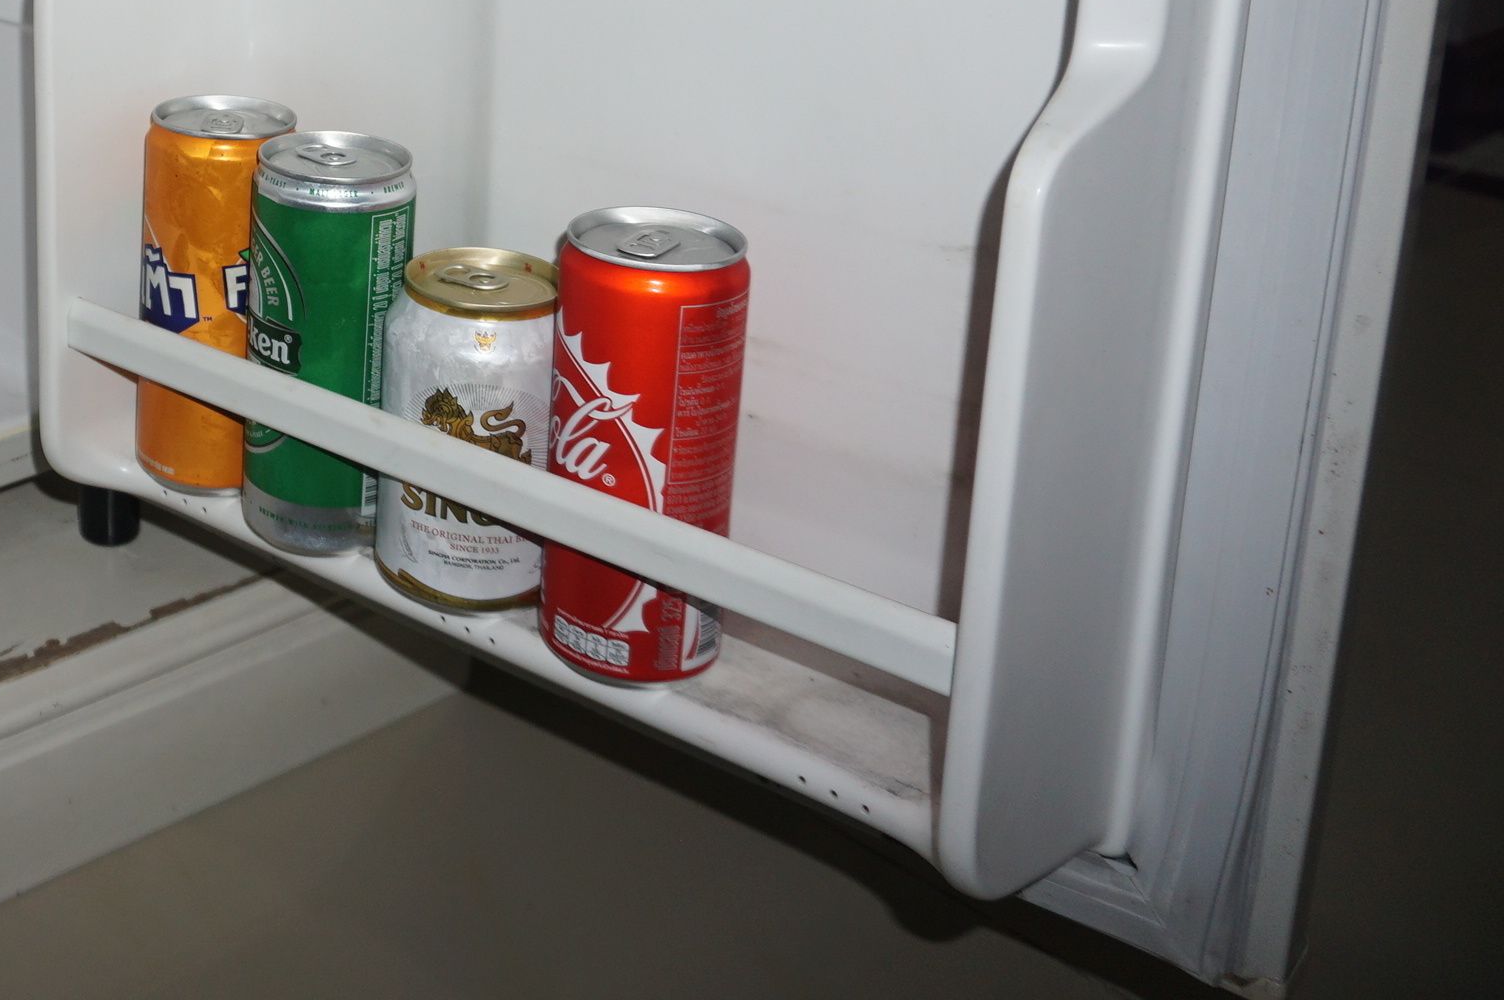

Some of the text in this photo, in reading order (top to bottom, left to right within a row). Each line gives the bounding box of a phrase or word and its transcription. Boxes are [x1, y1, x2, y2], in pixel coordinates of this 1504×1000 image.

[261, 266, 280, 306] BEER
[411, 519, 430, 534] THE
[431, 528, 484, 544] ORIGINAL
[487, 535, 513, 545] THAI
[450, 543, 478, 554] SINCE
[451, 555, 496, 565] CORPORATION
